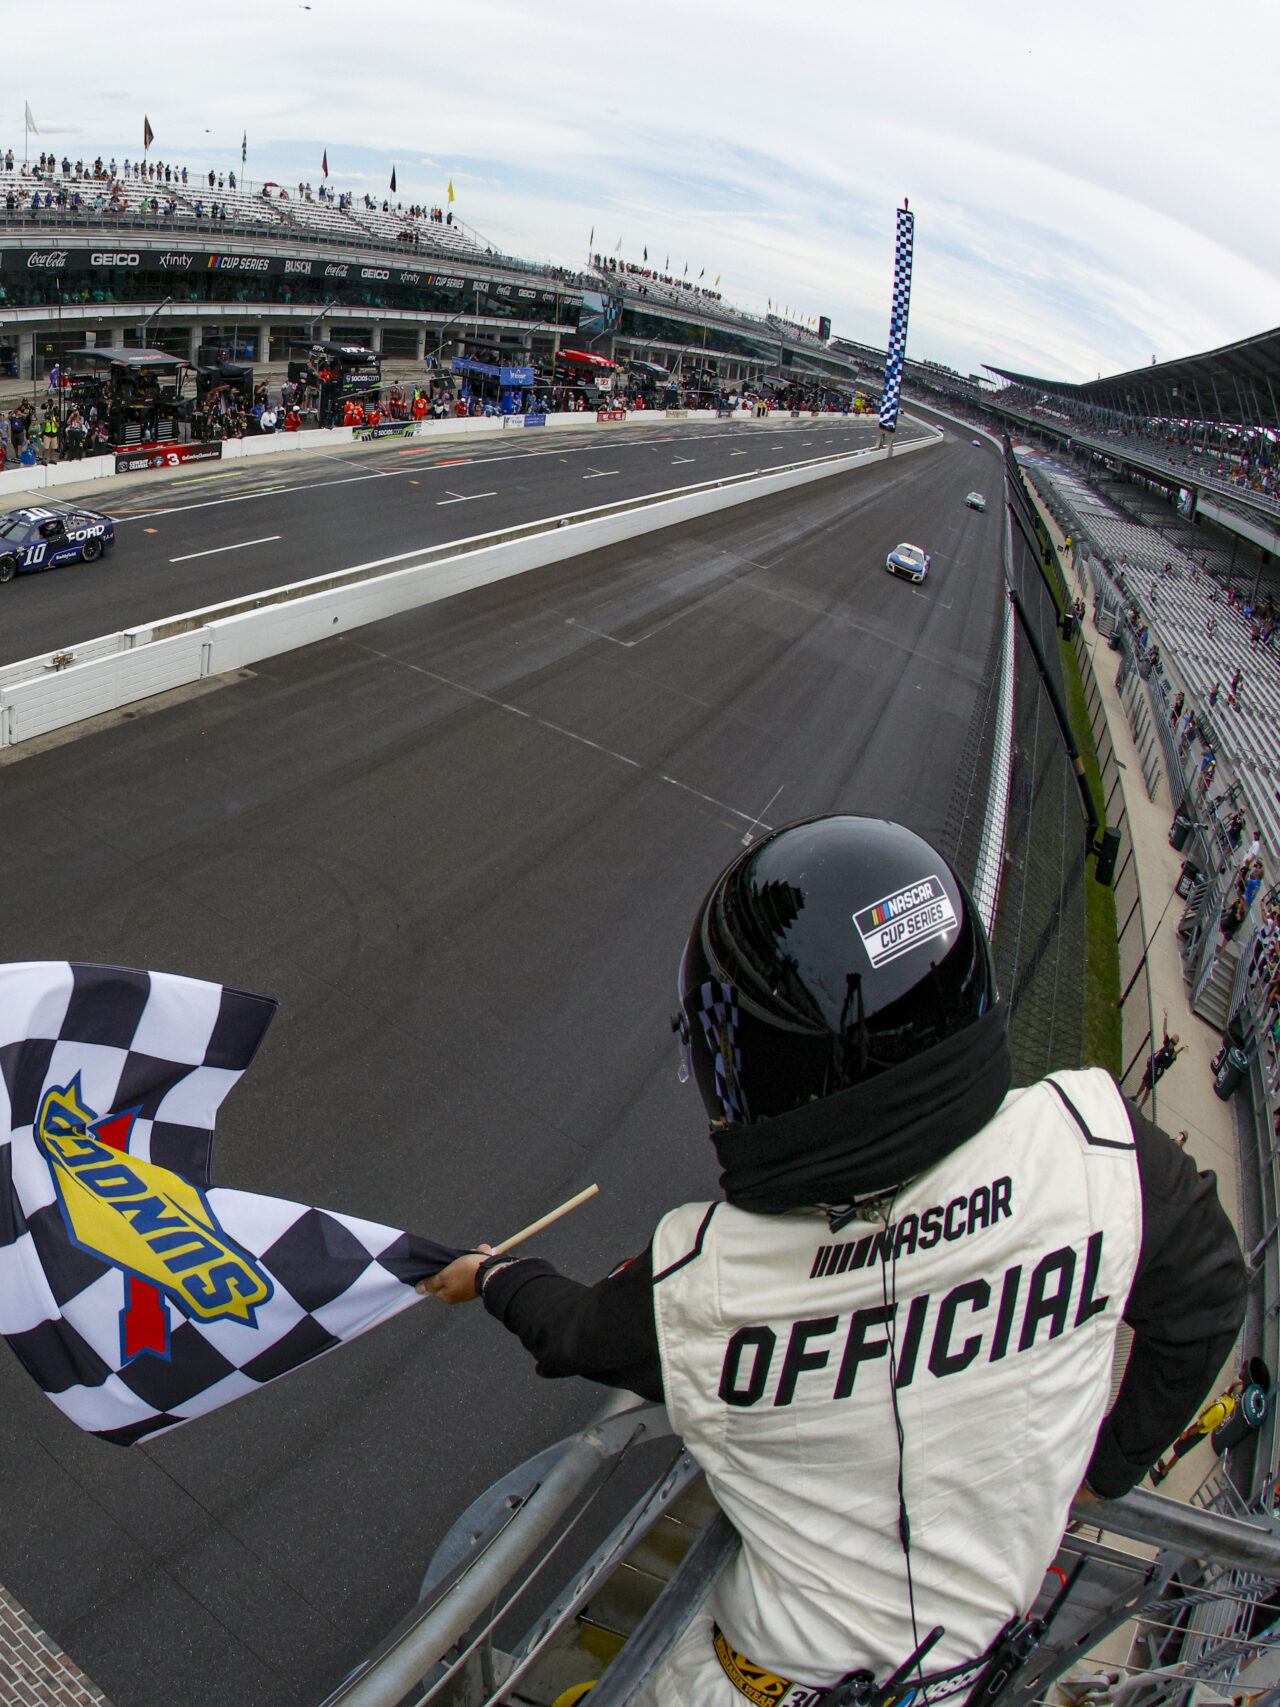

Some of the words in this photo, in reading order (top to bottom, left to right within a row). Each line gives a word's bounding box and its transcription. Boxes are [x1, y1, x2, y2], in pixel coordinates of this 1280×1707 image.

[90, 253, 140, 267] GEICO
[158, 252, 193, 269] xfinity
[221, 256, 239, 270] CUP
[240, 257, 270, 271] SERIES
[285, 260, 312, 275] BUSCH
[361, 268, 390, 280] GEICO
[399, 271, 420, 285] xfinity
[435, 276, 447, 286] CUP
[446, 278, 465, 288] SERIES
[472, 281, 489, 293] BUSCH
[518, 288, 537, 299] GEICO
[351, 374, 380, 382] socios.com
[166, 453, 180, 466] 3
[22, 507, 52, 522] 10
[66, 524, 105, 543] FORD
[23, 543, 48, 566] 10
[888, 881, 935, 920] NASCAR
[879, 920, 907, 949] CUP
[906, 903, 946, 937] SERIES
[868, 1175, 1013, 1267] NASCAR
[718, 1231, 1109, 1407] OFFICIAL
[744, 1683, 776, 1707] WEAR
